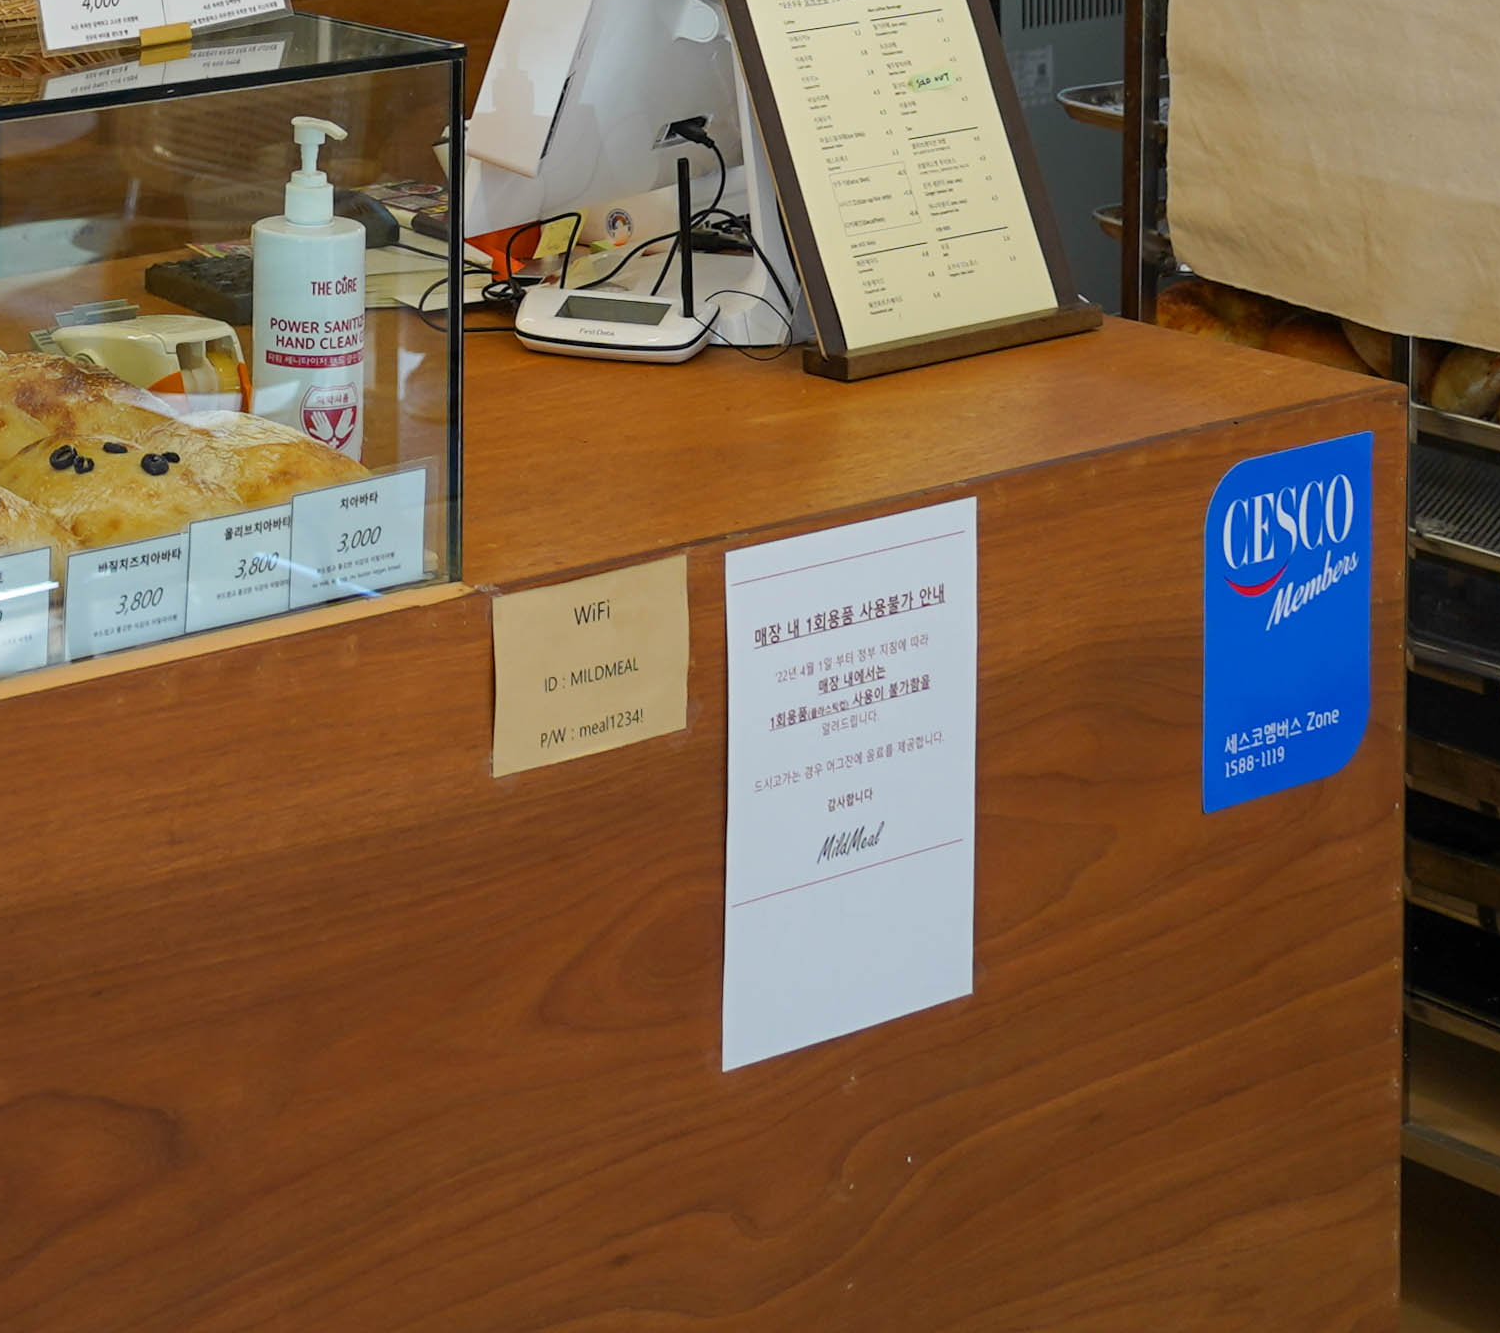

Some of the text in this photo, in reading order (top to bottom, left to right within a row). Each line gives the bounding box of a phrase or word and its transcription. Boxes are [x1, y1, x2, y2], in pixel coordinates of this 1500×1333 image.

[311, 275, 358, 296] THE CURE
[270, 317, 319, 334] POWER
[275, 335, 358, 350] HAND CLEAN
[98, 547, 182, 574] 바질치즈치아바타
[340, 491, 379, 511] 치아바타
[1222, 473, 1355, 571] CESCO
[115, 587, 164, 616] 3,800
[234, 552, 280, 580] 3,800
[336, 525, 382, 554] 3,000
[1265, 550, 1360, 632] Members
[574, 599, 611, 626] WiFi
[754, 583, 945, 646] 매장 내 1회용품 사용불가 안내
[544, 657, 639, 693] ID MILDMEAL
[835, 651, 854, 667] 부터
[818, 665, 886, 694] 매장 내에서는
[853, 686, 885, 707] 사용이
[888, 674, 931, 698] 불가함을
[540, 708, 644, 750] P/W meal1234!
[1224, 708, 1340, 756] 세스코멤버스 Zone
[1224, 745, 1286, 779] 1588-1119
[827, 787, 873, 812] 감사합니다
[817, 820, 885, 865] MildMeal
